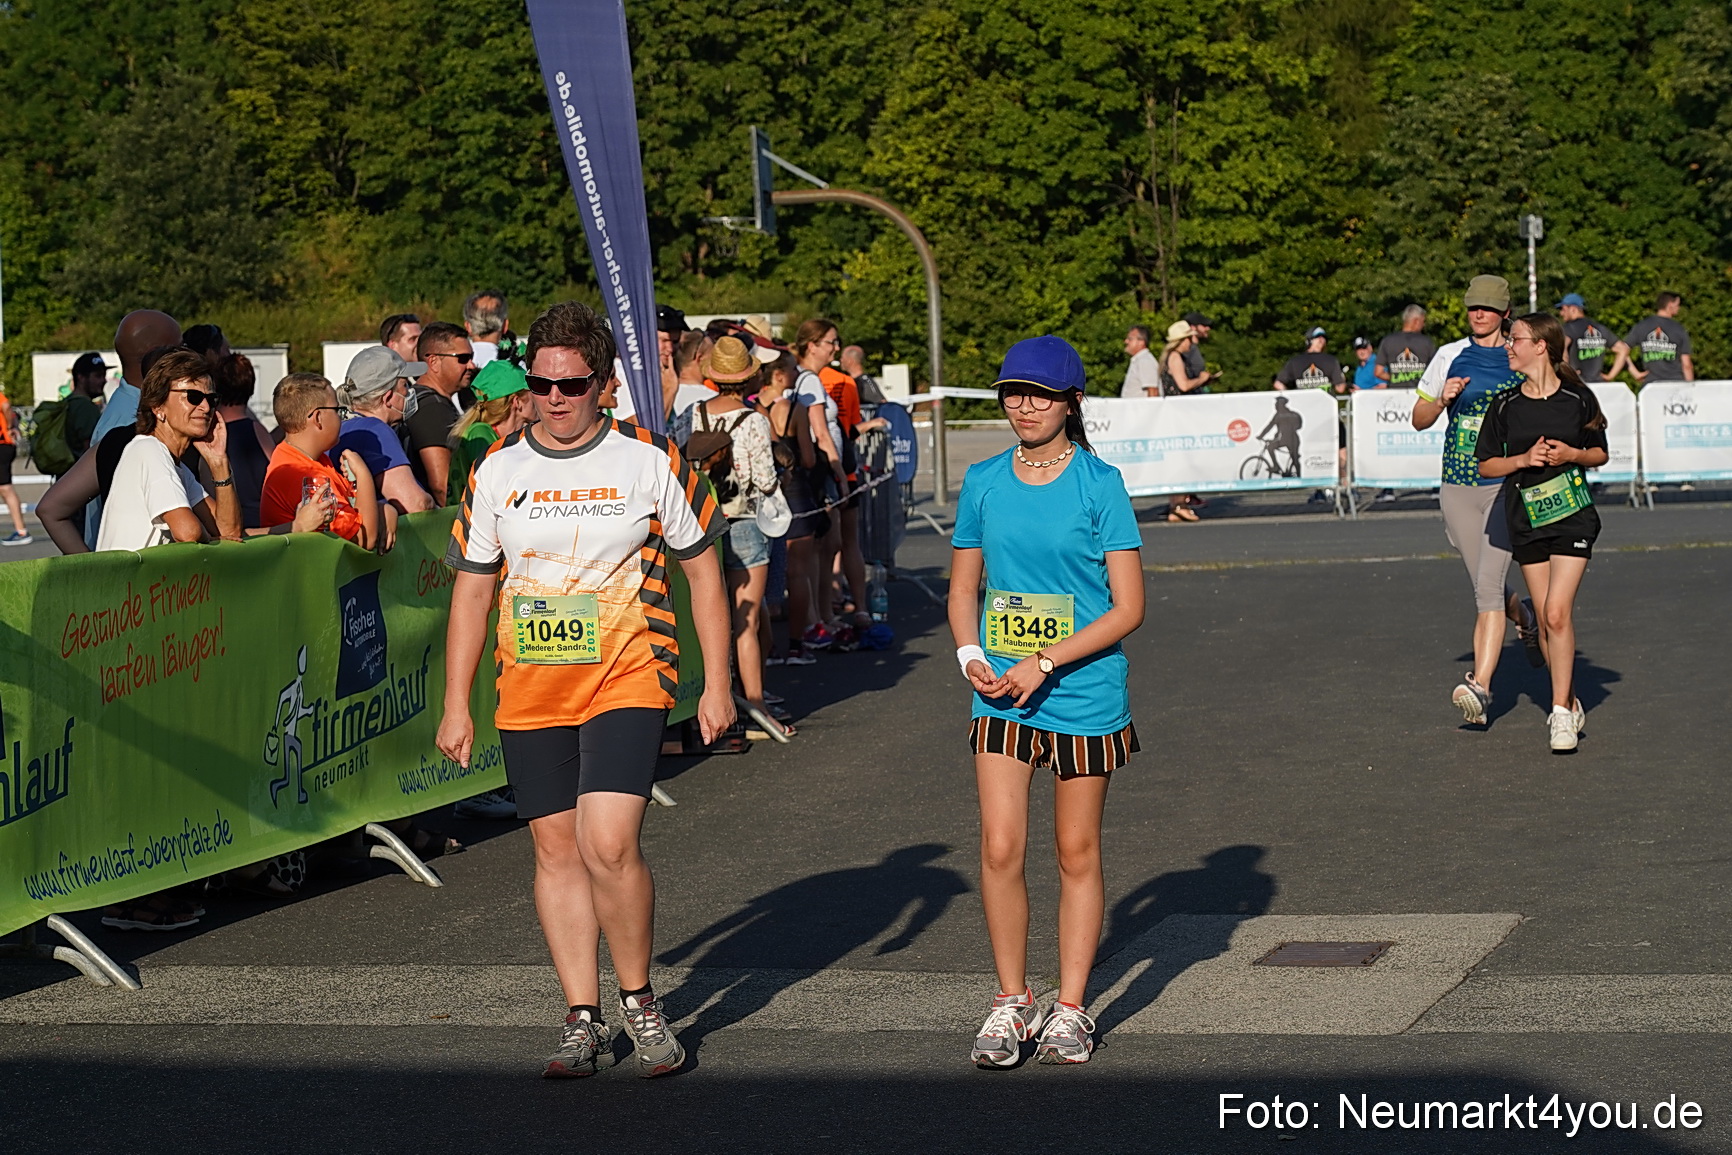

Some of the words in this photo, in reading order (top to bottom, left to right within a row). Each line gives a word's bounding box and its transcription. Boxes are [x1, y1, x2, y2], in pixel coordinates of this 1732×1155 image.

[1377, 410, 1411, 423] NOW
[1663, 403, 1698, 416] NOW
[1378, 432, 1432, 446] E-BIKES
[1666, 425, 1719, 439] E-BIKES
[532, 487, 626, 503] KLEBL
[1535, 493, 1563, 512] 298
[528, 502, 626, 520] DYNAMICS
[61, 581, 145, 660] Gesunde
[149, 573, 212, 623] Firmen
[349, 608, 376, 639] Fischer
[517, 622, 526, 654] WALK
[526, 618, 584, 642] 1049
[586, 622, 596, 653] 2022
[990, 615, 998, 646] WALK
[1000, 614, 1058, 639] 1348
[525, 644, 555, 652] Mederer
[557, 643, 587, 652] Sandra
[1003, 638, 1036, 648] Haubner
[100, 643, 157, 706] laufen
[162, 606, 226, 683] länger!
[311, 643, 432, 765] firmenlauf
[314, 744, 369, 793] neumarkt
[24, 809, 233, 900] www.firmenlauf-oberpfalz.de
